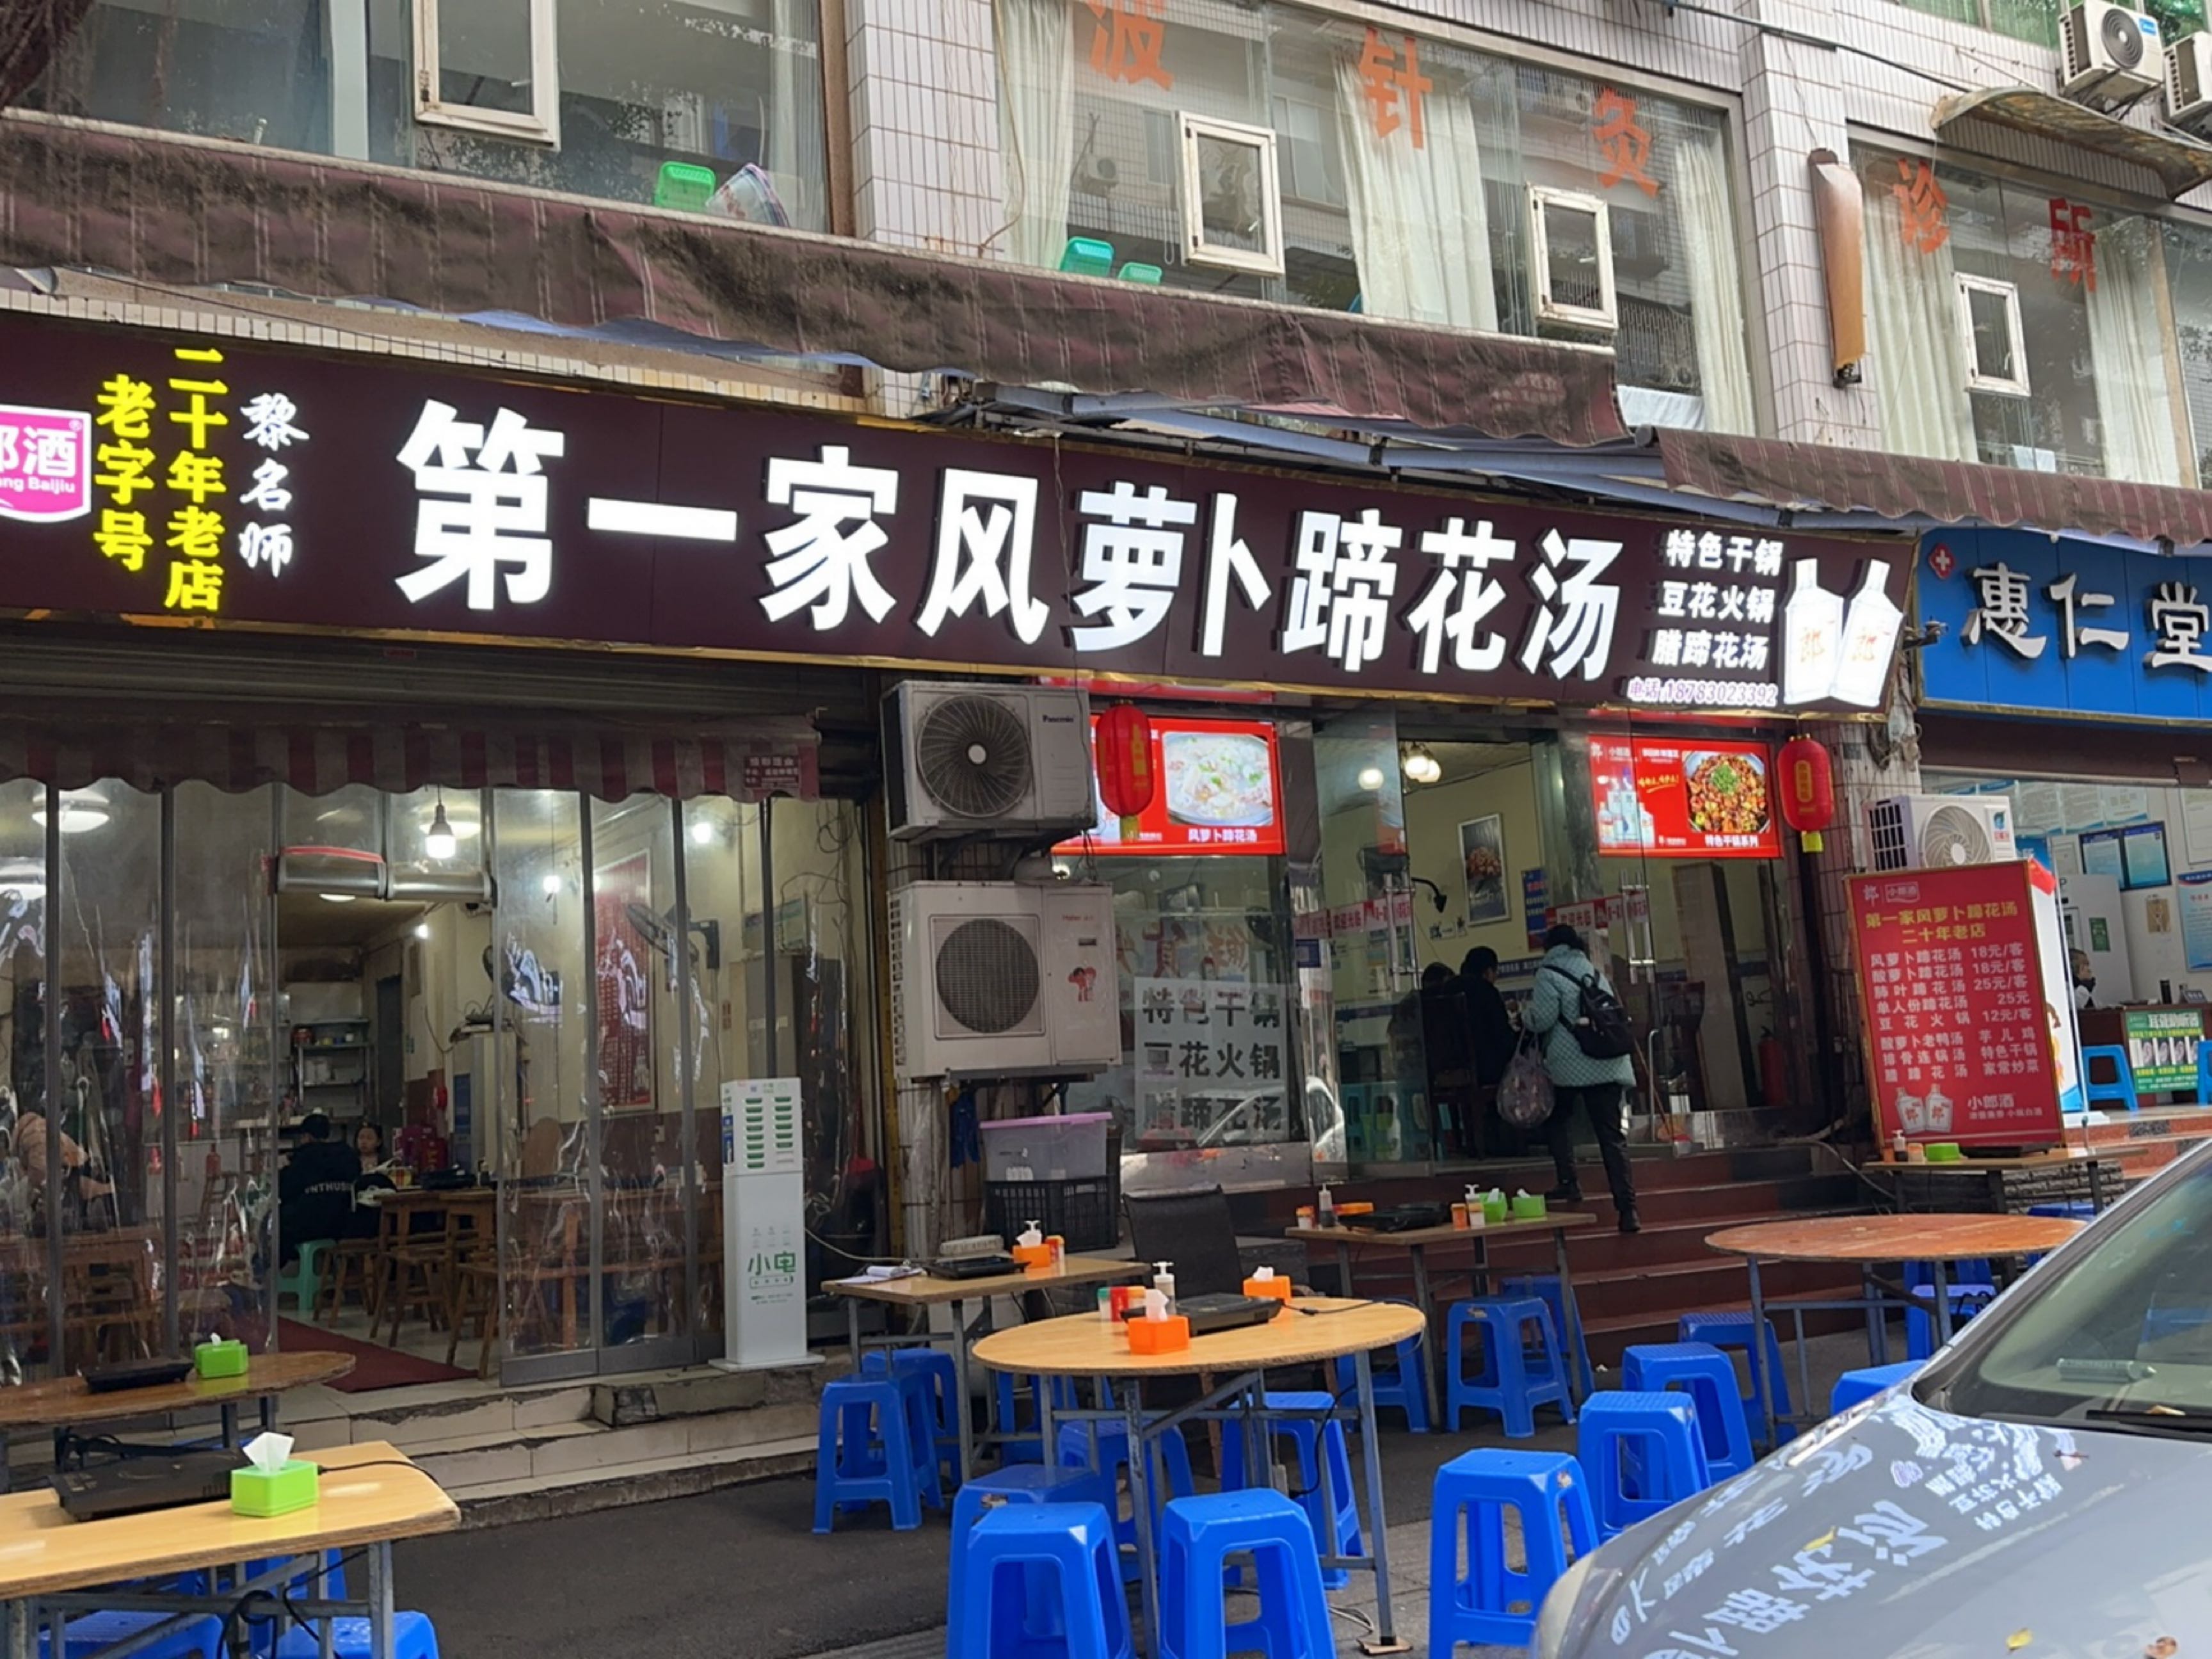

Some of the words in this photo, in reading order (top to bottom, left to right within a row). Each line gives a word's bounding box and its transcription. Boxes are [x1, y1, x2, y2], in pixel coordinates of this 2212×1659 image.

[28, 476, 76, 495] Baijiu
[93, 374, 156, 572] 老字号
[165, 348, 228, 612] 二十年老店
[239, 392, 310, 579] 黎名师
[394, 398, 1624, 682] 第一家风萝卜蹄花汤
[1666, 529, 1784, 576] 特色干锅
[1658, 581, 1775, 623] 豆花火锅
[1962, 562, 2212, 672] 惠仁堂
[1652, 629, 1769, 671] 腊蹄花汤
[1865, 901, 2018, 929] 第一家风萝卜蹄花汤
[1902, 923, 1986, 944] 二十年老店
[1142, 988, 1280, 1028] 特色干锅
[1144, 1041, 1280, 1079] 豆花火锅
